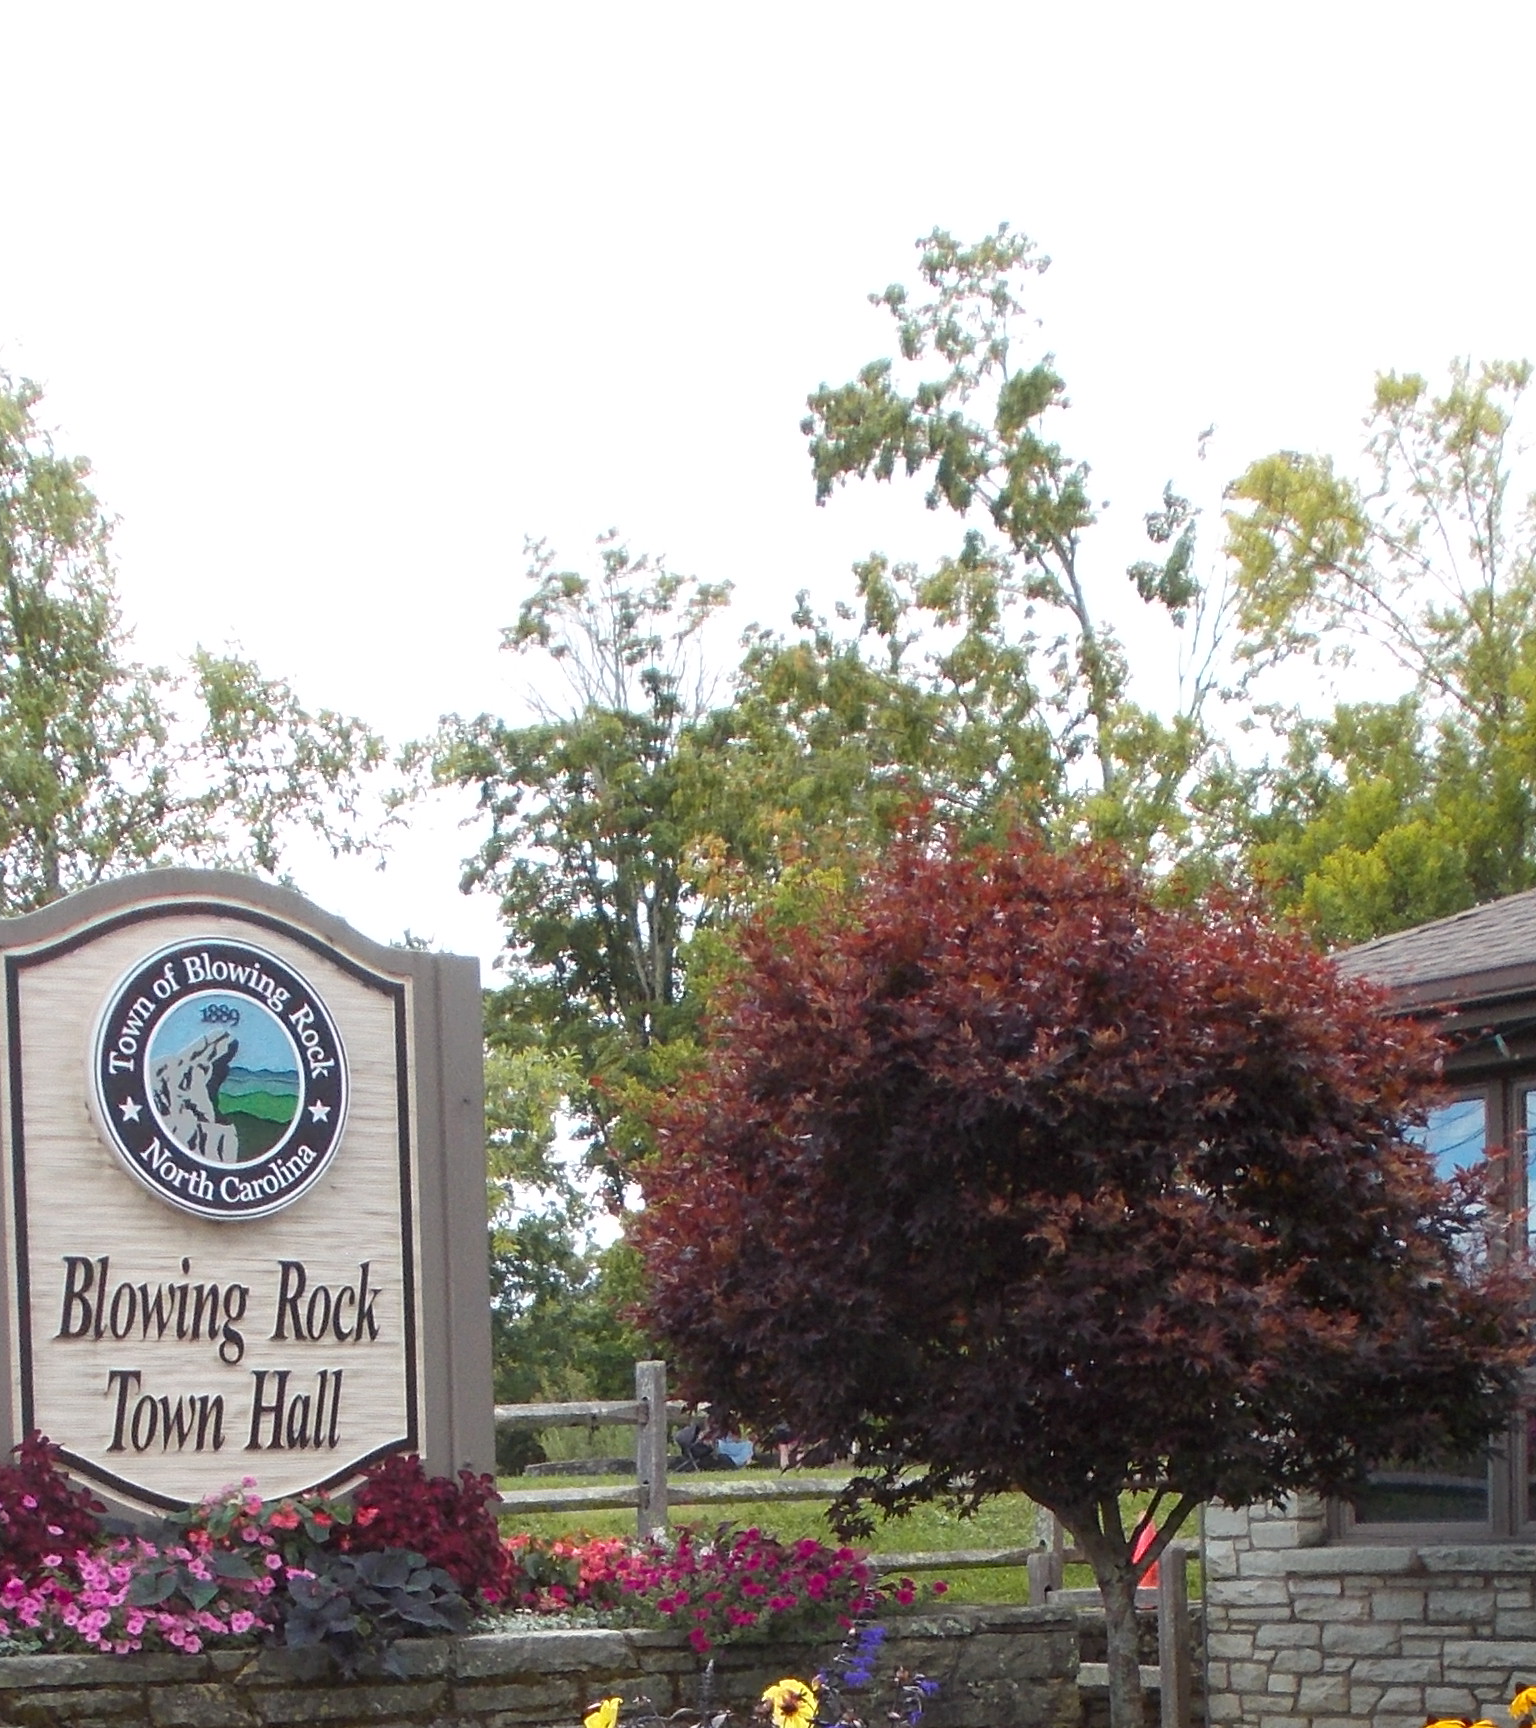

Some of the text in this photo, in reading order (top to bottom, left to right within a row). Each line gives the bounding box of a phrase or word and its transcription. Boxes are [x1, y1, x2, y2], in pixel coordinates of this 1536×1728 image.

[109, 952, 335, 1079] Town of Blowing Rock
[200, 1003, 240, 1026] 1889
[140, 1137, 317, 1203] North Carolina
[52, 1254, 382, 1365] Blowing Rock
[104, 1368, 343, 1452] Town Hall
